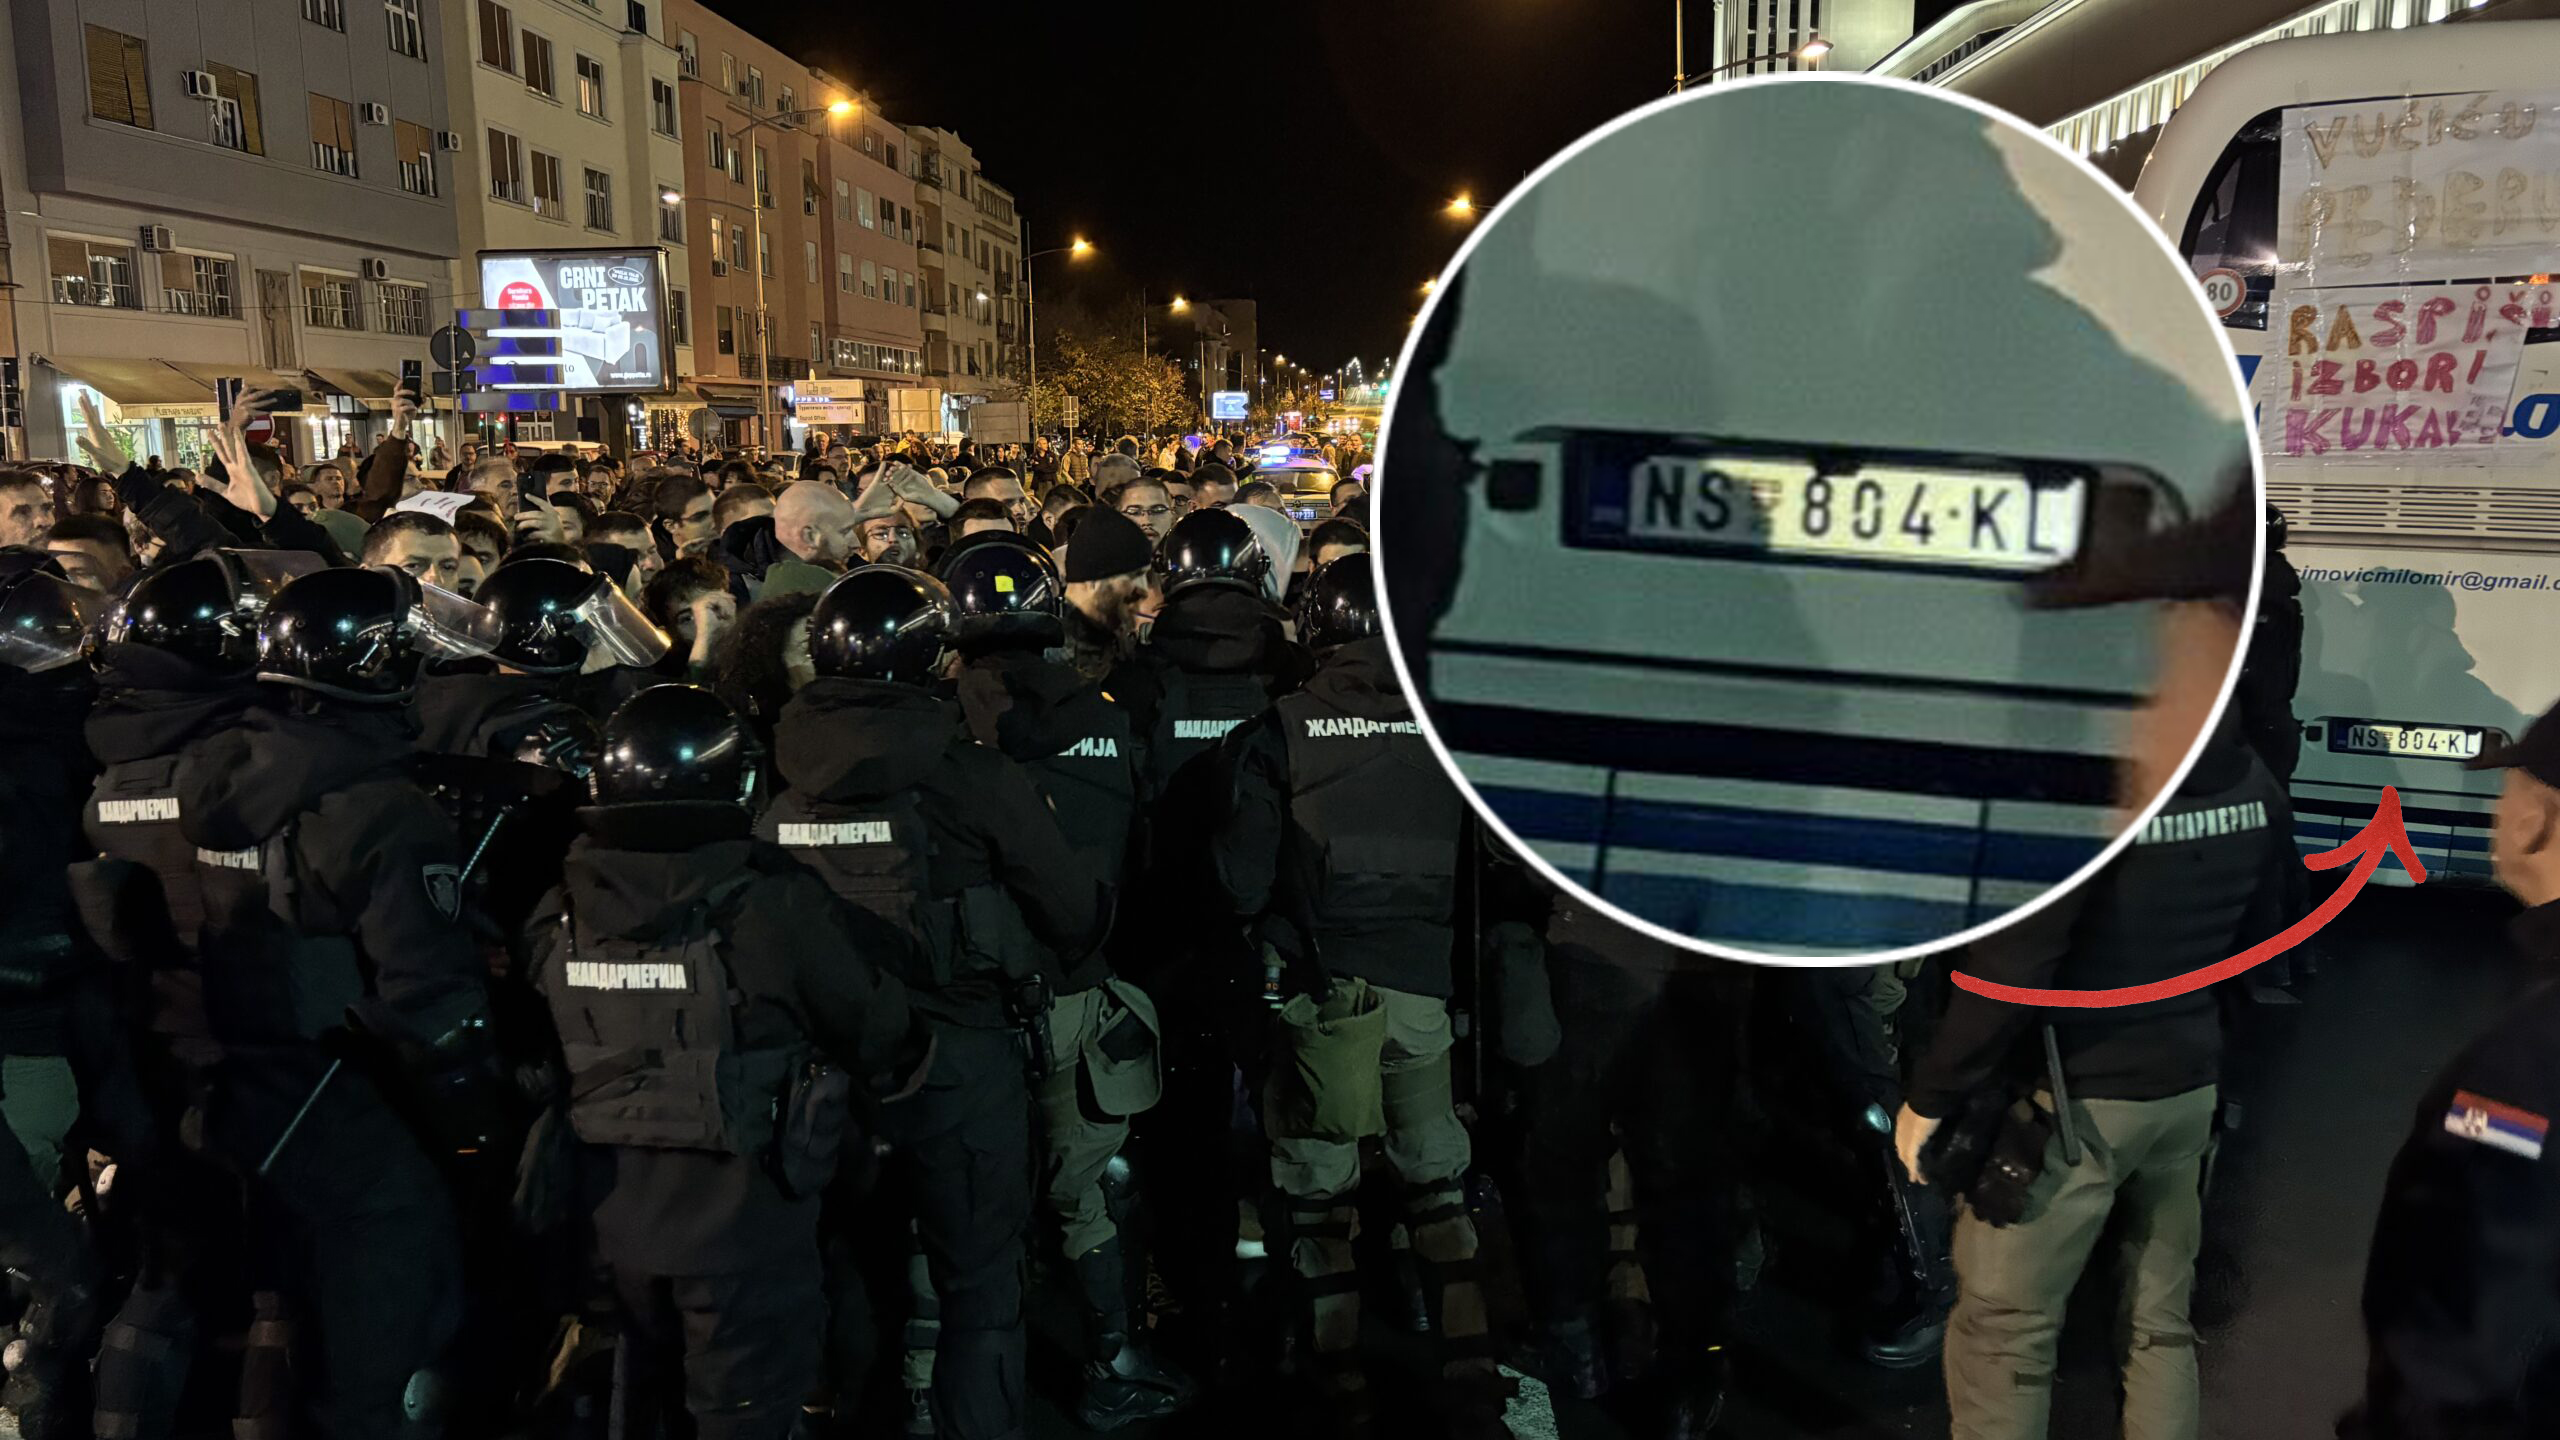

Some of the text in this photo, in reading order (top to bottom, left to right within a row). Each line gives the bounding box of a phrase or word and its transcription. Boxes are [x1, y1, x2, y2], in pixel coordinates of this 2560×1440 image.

[2304, 95, 2537, 170] VUČIĆU
[560, 266, 607, 289] CRNI
[582, 287, 648, 312] PETAK
[2207, 282, 2233, 301] 80
[2291, 349, 2487, 401] IZBORI
[1644, 464, 1732, 532] NS
[1174, 719, 1247, 740] ЖАНДАРМ
[2352, 727, 2379, 748] NS
[98, 797, 180, 824] ЖАНДАРМЕРИЈА
[778, 820, 893, 847] ЖАНДАРМЕРИЈА
[566, 961, 687, 990] ЖАНДАРМЕРИЈА
